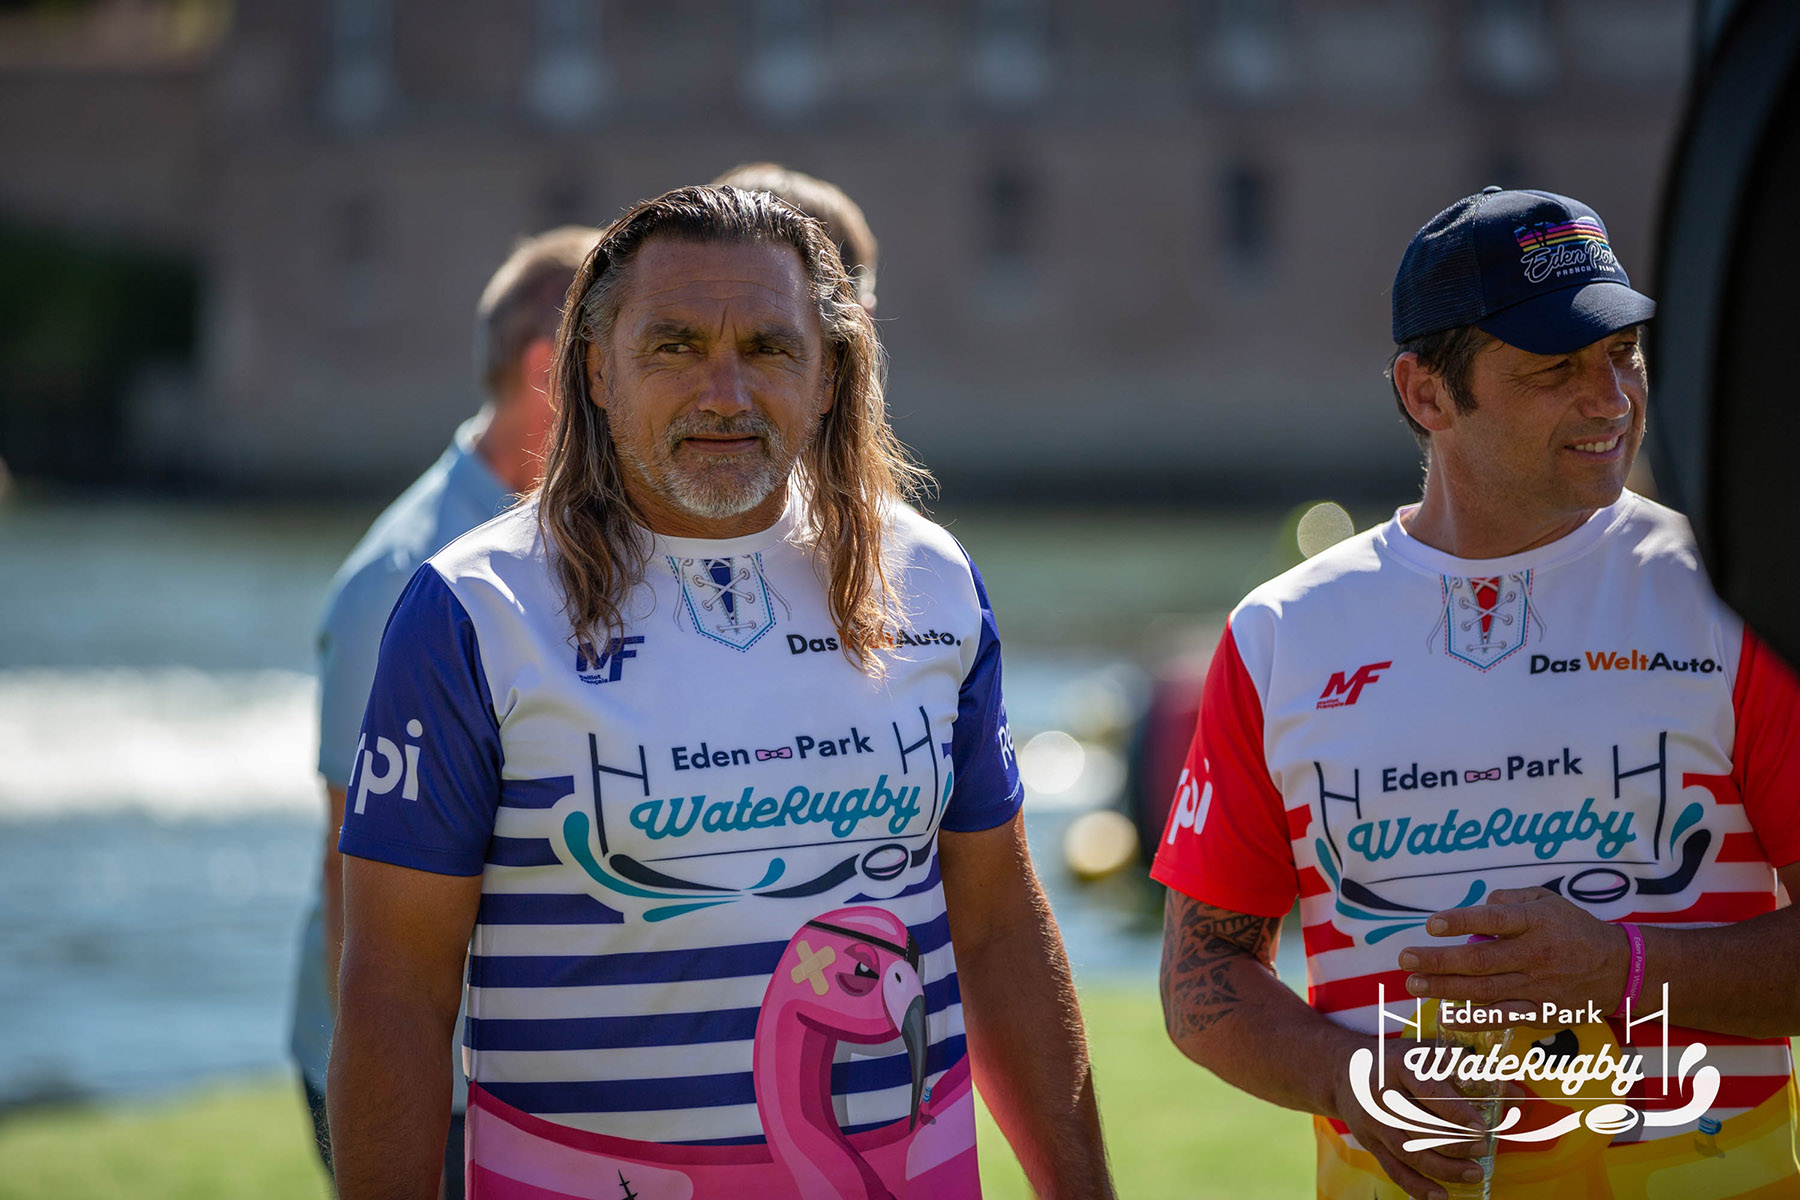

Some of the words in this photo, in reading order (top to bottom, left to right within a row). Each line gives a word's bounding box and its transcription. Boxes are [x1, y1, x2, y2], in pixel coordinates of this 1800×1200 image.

[1520, 244, 1586, 284] Eden
[1556, 265, 1591, 278] FRENCH
[786, 634, 838, 655] Das
[1530, 654, 1581, 675] Das
[1319, 660, 1393, 706] MF
[673, 743, 750, 771] Eden
[795, 727, 874, 759] Park
[1381, 762, 1457, 793] Eden
[1507, 748, 1583, 780] Park
[629, 775, 920, 840] WateRugby
[1347, 798, 1637, 862] WateRugby
